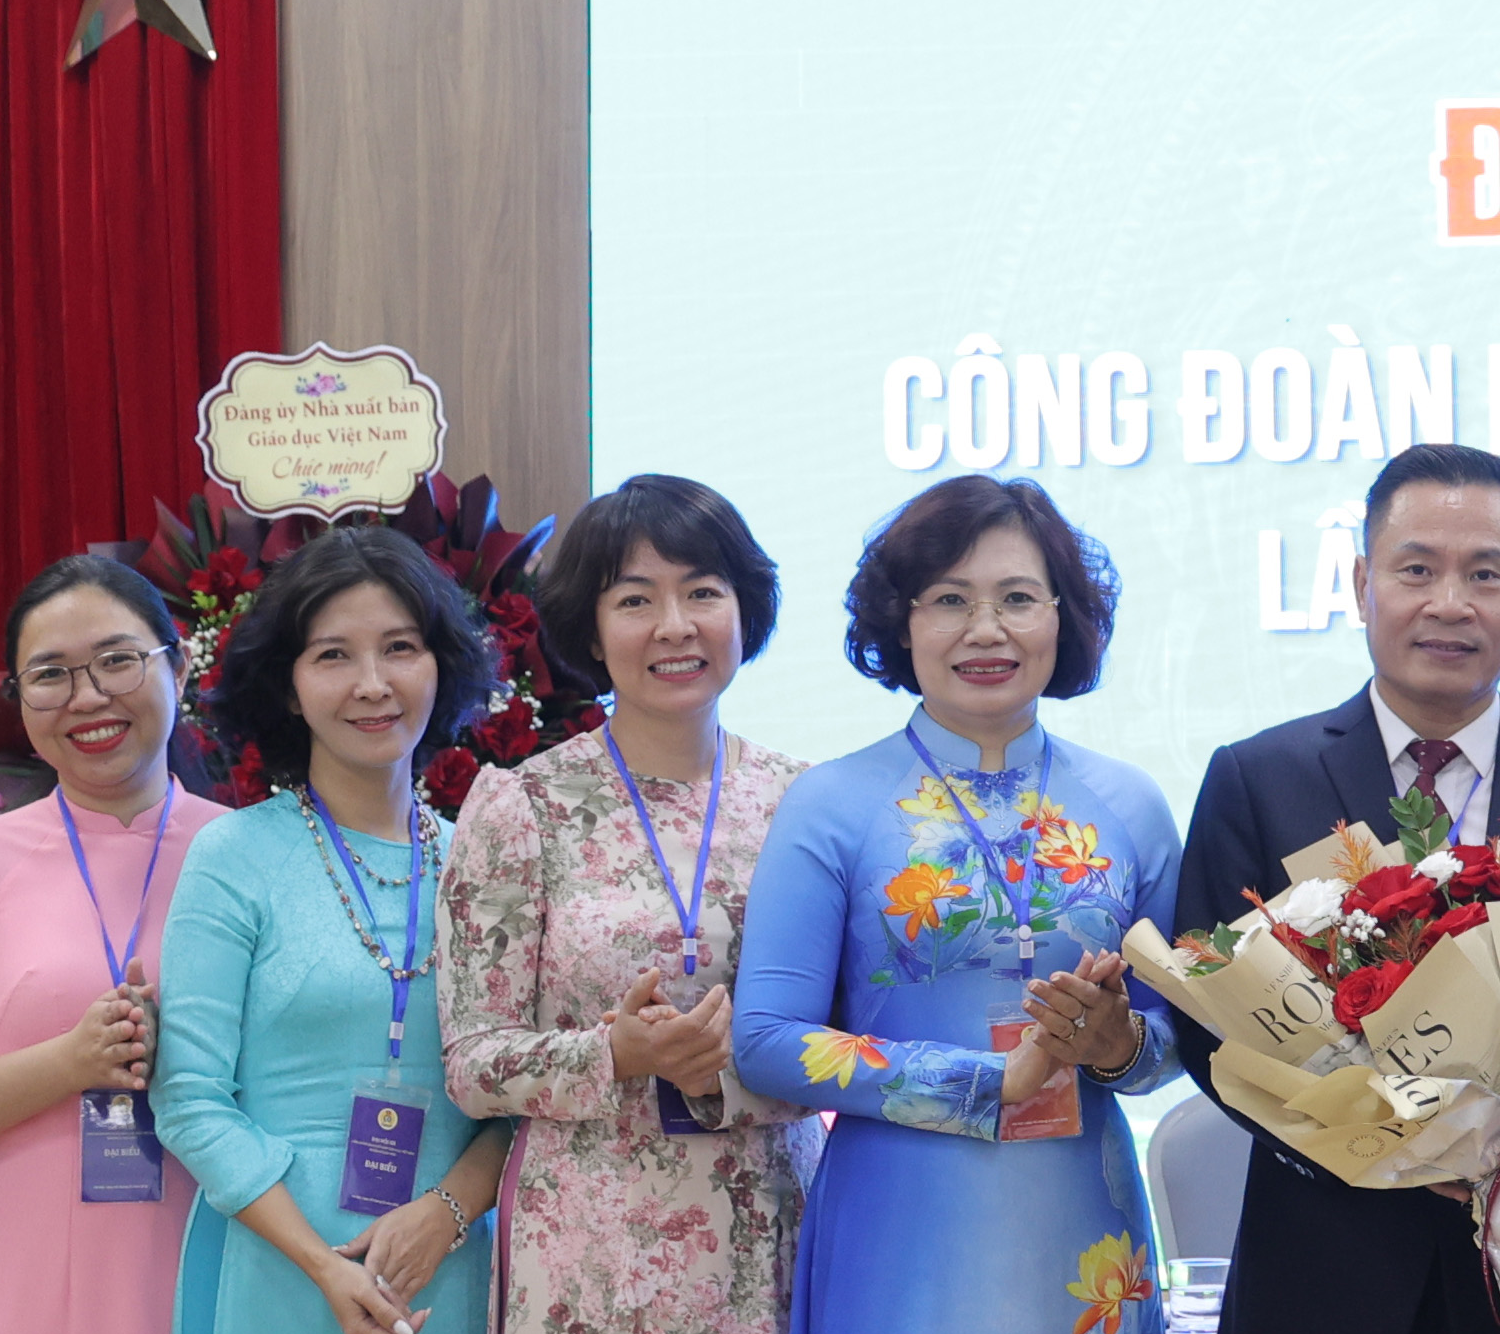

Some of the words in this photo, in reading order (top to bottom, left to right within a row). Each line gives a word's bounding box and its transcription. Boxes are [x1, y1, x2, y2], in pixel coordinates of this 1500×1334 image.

[884, 333, 1150, 469] CÔNG
[1178, 324, 1453, 463] ĐOÀN
[224, 404, 271, 424] Đảng
[303, 400, 339, 417] Nhà
[344, 397, 382, 416] xuất
[388, 396, 420, 413] bản
[248, 430, 287, 447] Giáo
[291, 429, 321, 448] dục
[327, 428, 362, 447] Việt
[368, 427, 407, 441] Nam
[272, 455, 324, 479] Chúc
